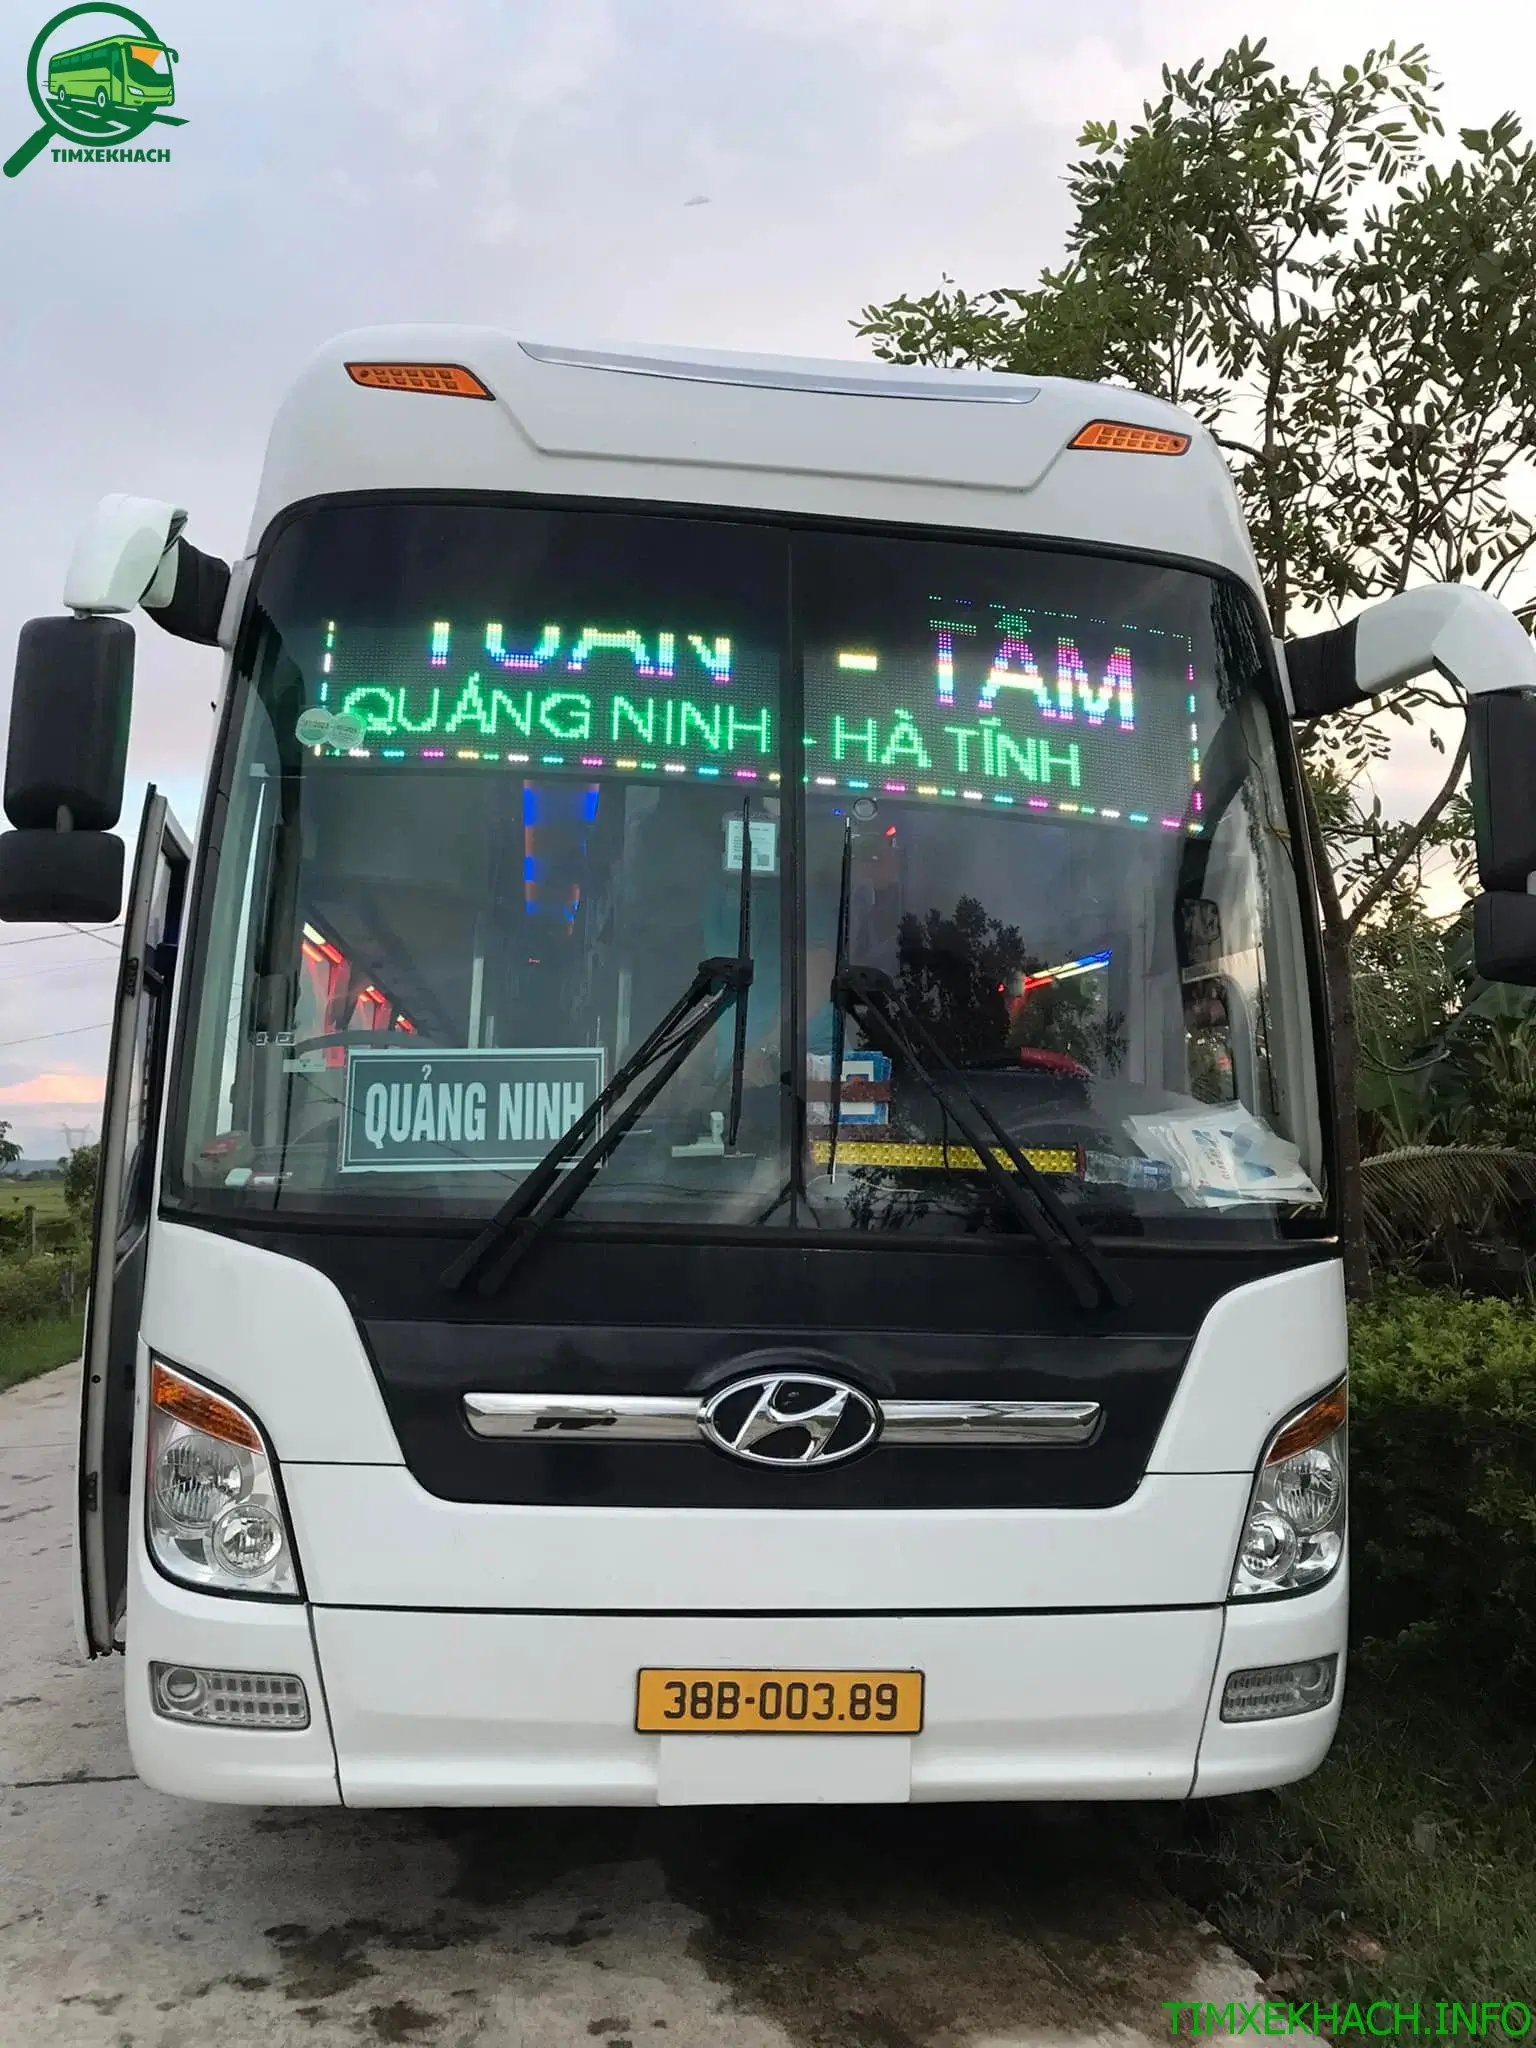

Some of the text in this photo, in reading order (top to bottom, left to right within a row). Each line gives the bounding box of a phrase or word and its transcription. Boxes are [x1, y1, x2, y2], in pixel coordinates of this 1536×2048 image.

[613, 696, 771, 753] NINH
[835, 709, 932, 768] HÀ
[944, 717, 1080, 787] TĨNH
[365, 1064, 584, 1149] QUẢNG NINH
[663, 1681, 898, 1721] 38B-003.89
